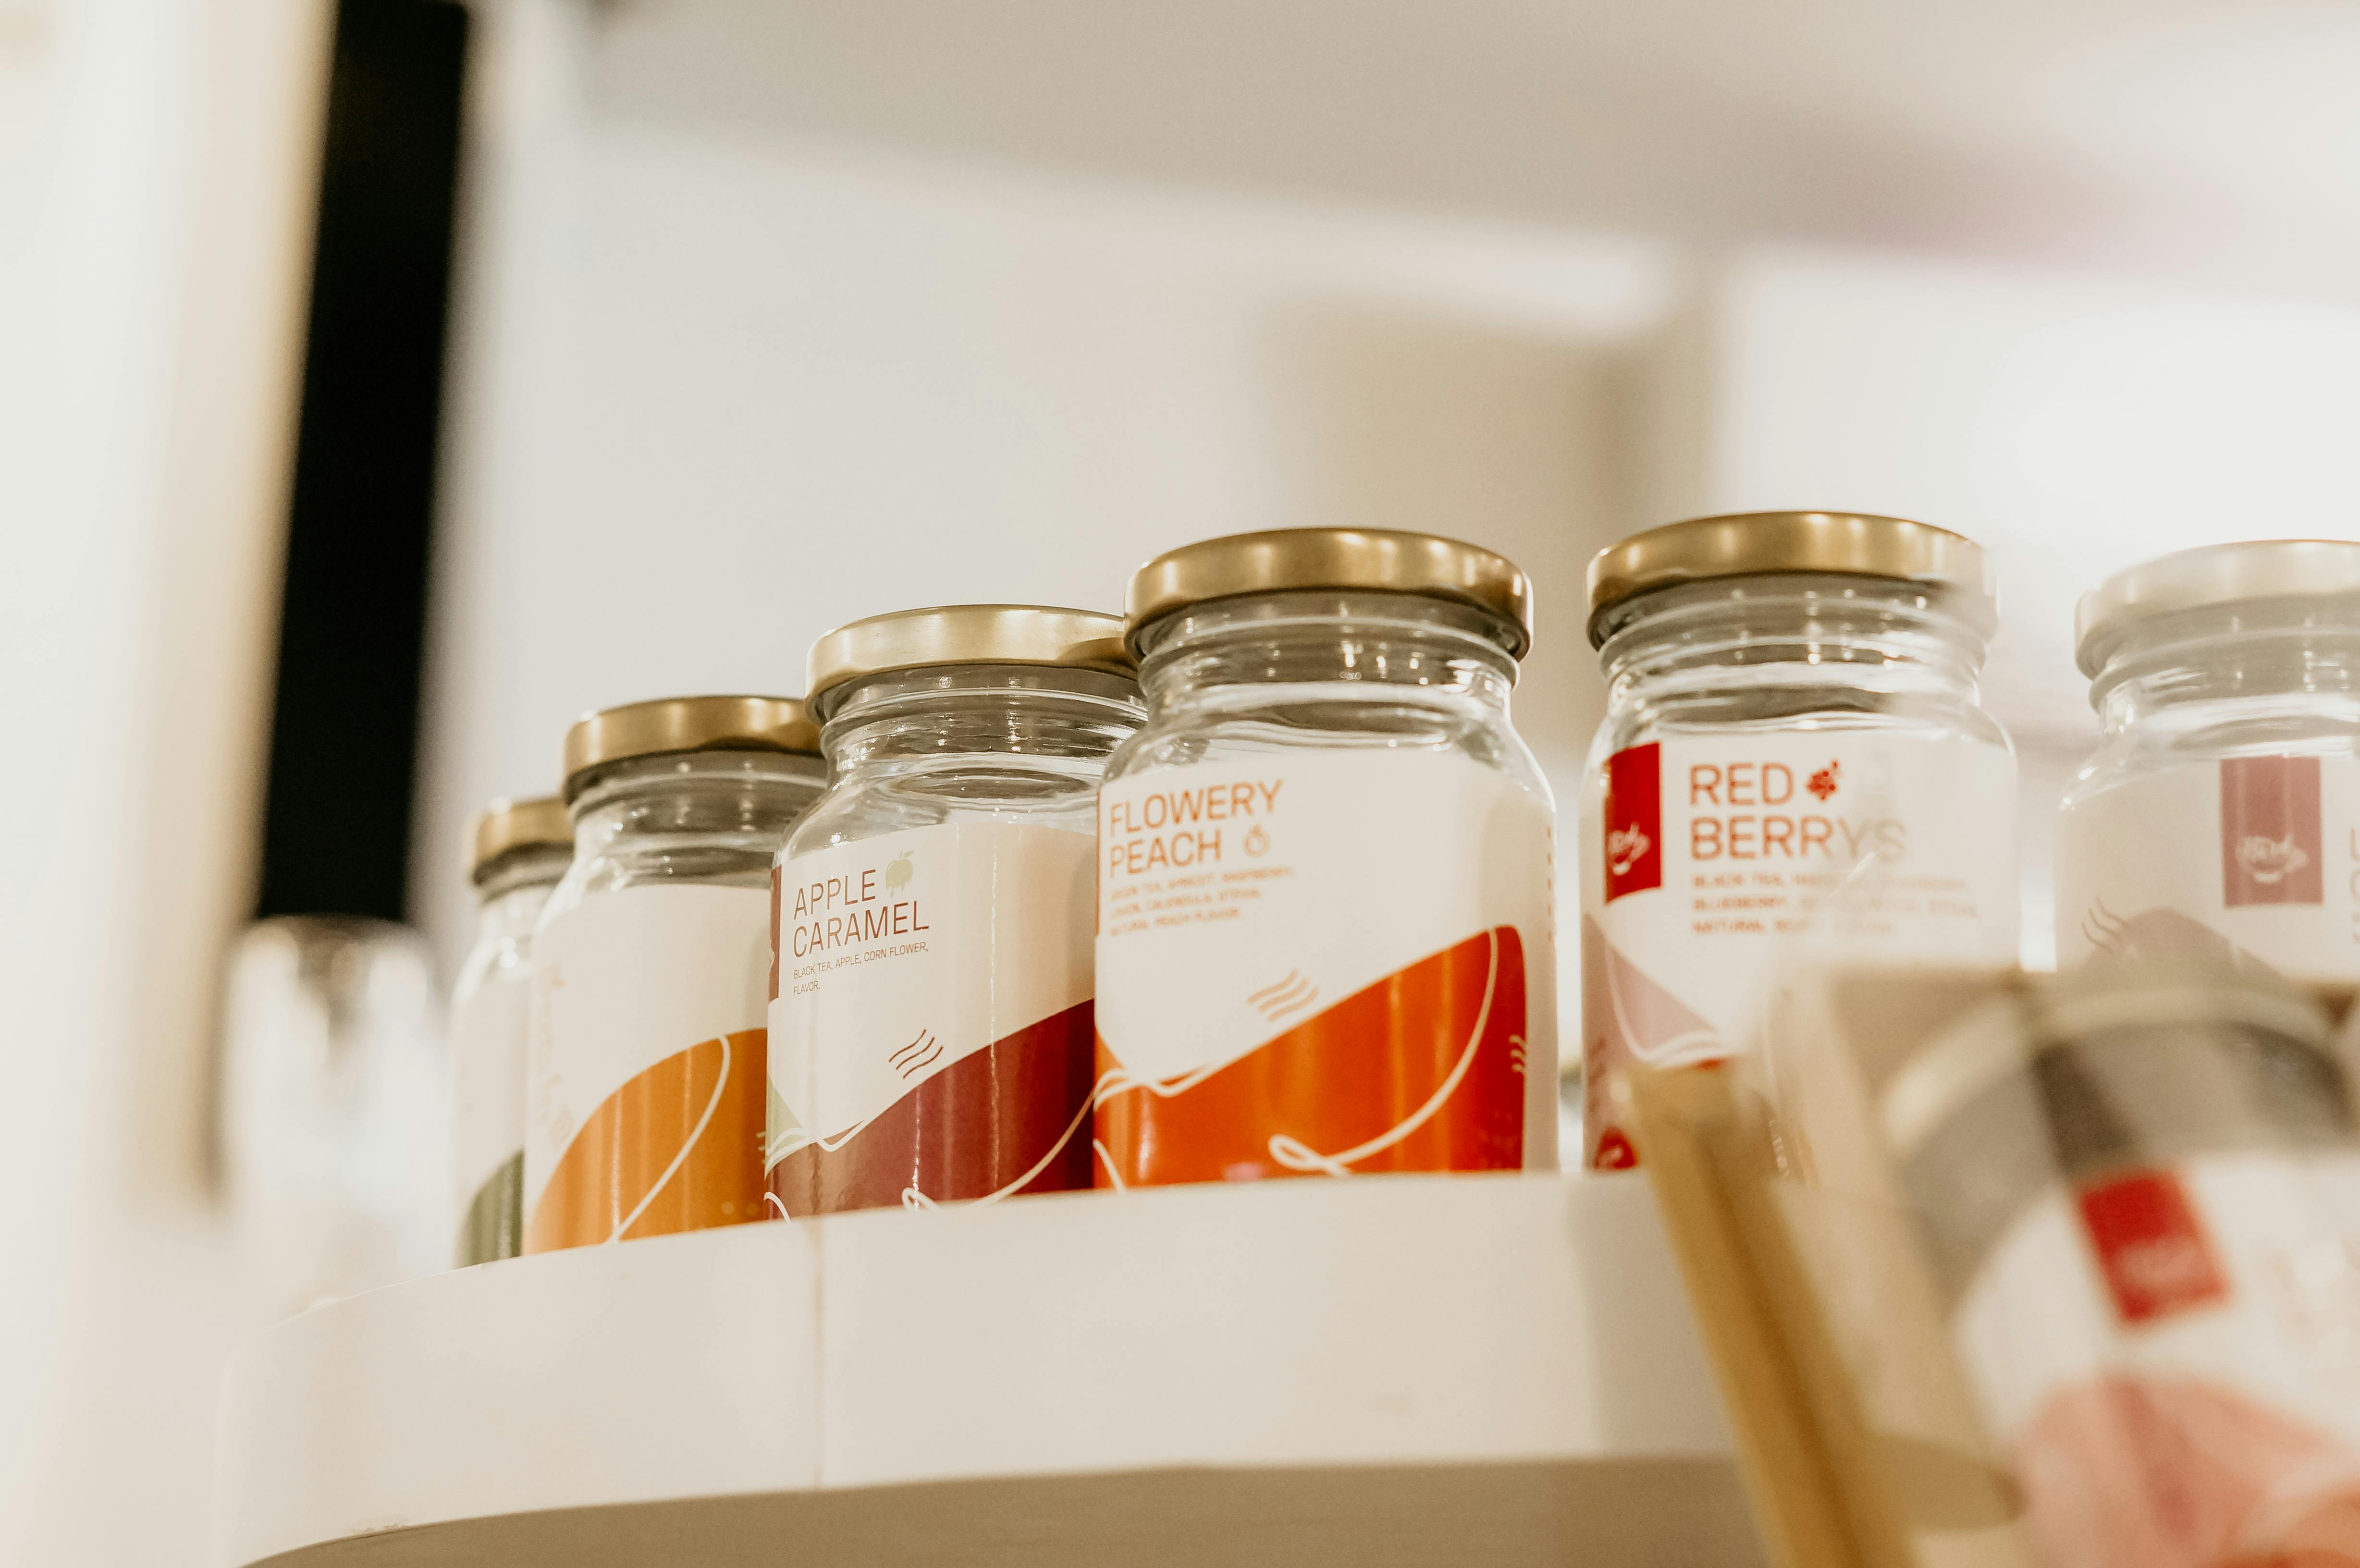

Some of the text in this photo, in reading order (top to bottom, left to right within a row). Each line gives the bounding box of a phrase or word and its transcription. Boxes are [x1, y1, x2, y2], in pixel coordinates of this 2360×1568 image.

[1689, 763, 1794, 806] RED
[1110, 779, 1283, 838] FLOWERY
[1110, 827, 1222, 879] PEACH
[1690, 816, 1906, 861] BERRYS
[794, 869, 876, 919] APPLE
[794, 901, 930, 957] CARAMEL
[794, 942, 929, 979] BLACK TEA, APPLE, CORN FLOWER,
[793, 980, 821, 995] FLAVOR.
